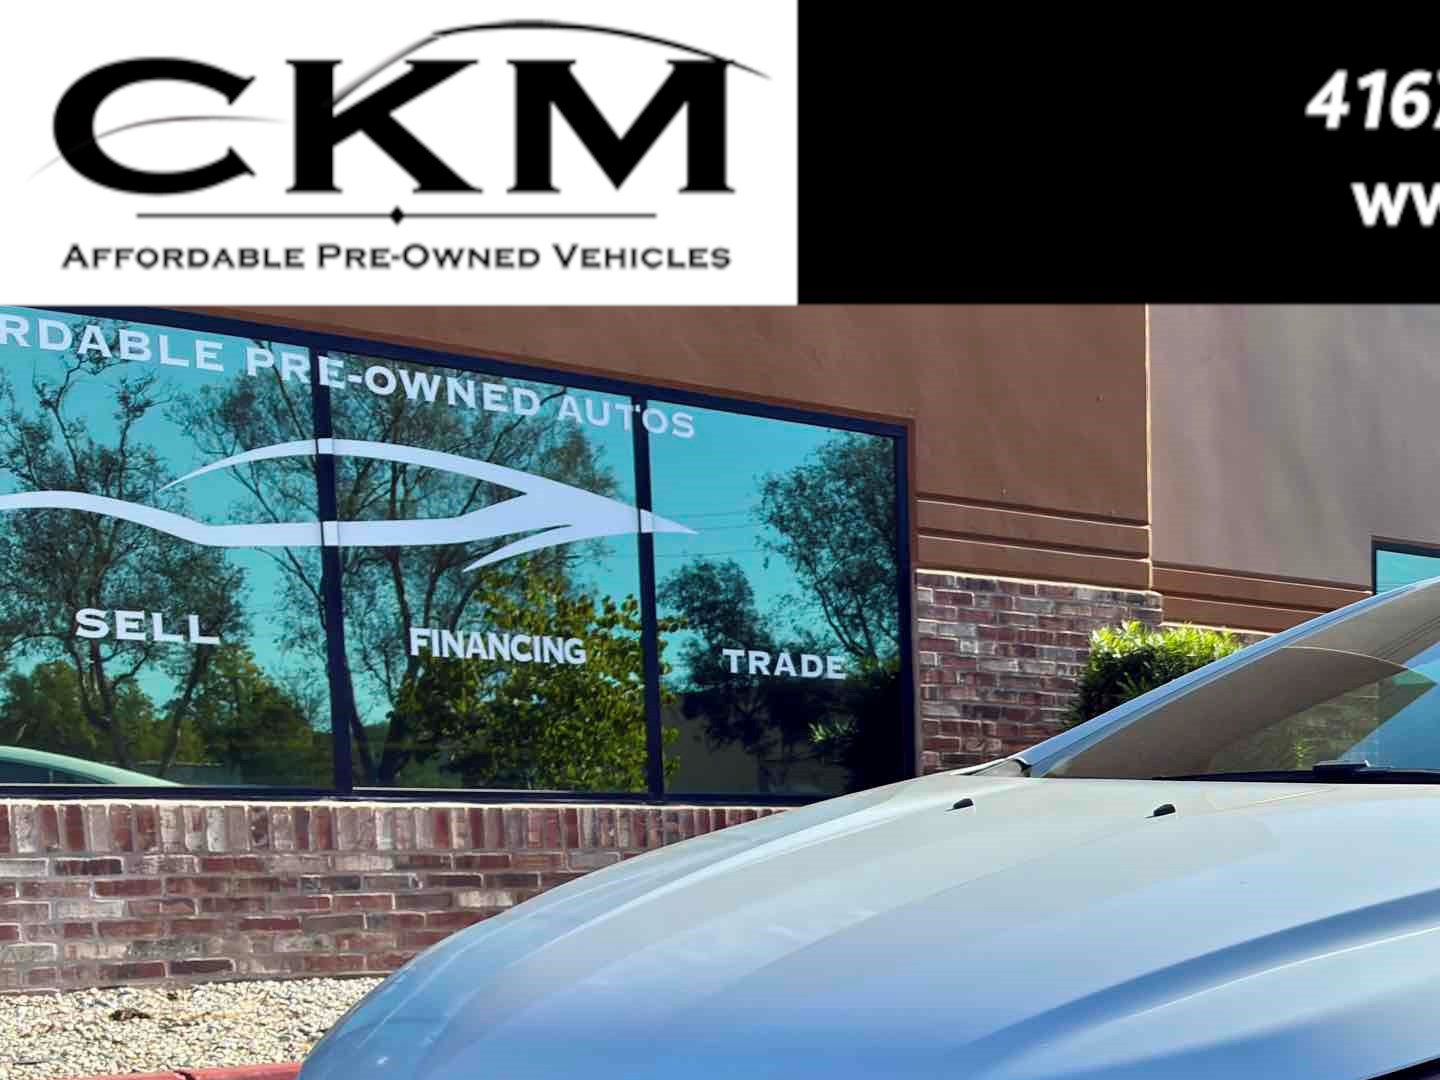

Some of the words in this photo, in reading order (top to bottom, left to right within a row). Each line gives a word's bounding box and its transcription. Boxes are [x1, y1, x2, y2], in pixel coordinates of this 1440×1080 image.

[245, 346, 541, 417] PRE-OWNED
[558, 400, 696, 440] AUTOS
[75, 608, 220, 645] SELL
[409, 627, 587, 665] FINANCING
[722, 647, 847, 681] TRADE
